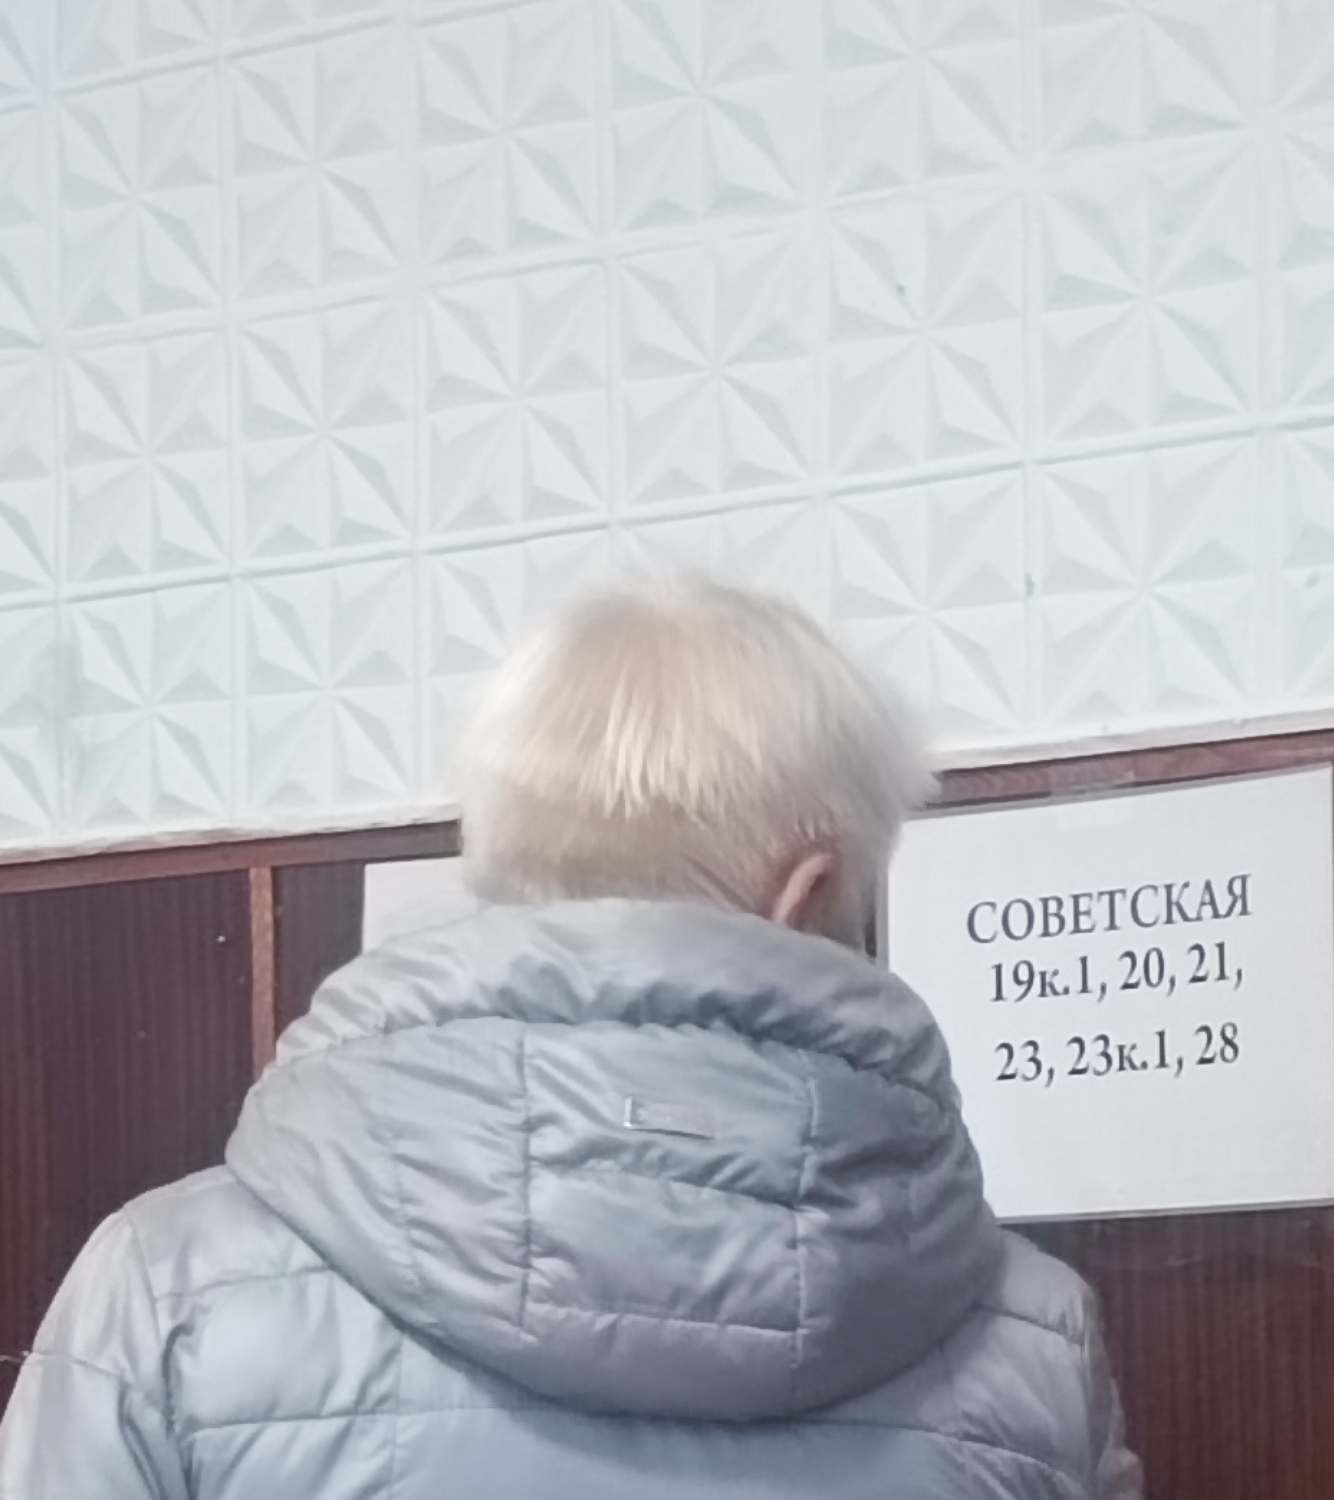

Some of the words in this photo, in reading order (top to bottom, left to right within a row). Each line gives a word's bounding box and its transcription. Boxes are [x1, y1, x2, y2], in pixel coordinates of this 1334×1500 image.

[967, 873, 1253, 944] СОВЕТСКАЯ
[990, 955, 1107, 1003] 19к.1,
[1119, 947, 1176, 997] 20,
[1187, 940, 1243, 989] 21,
[995, 1040, 1055, 1088] 23,
[1067, 1030, 1184, 1079] 23к.1,
[1194, 1021, 1240, 1066] 28
